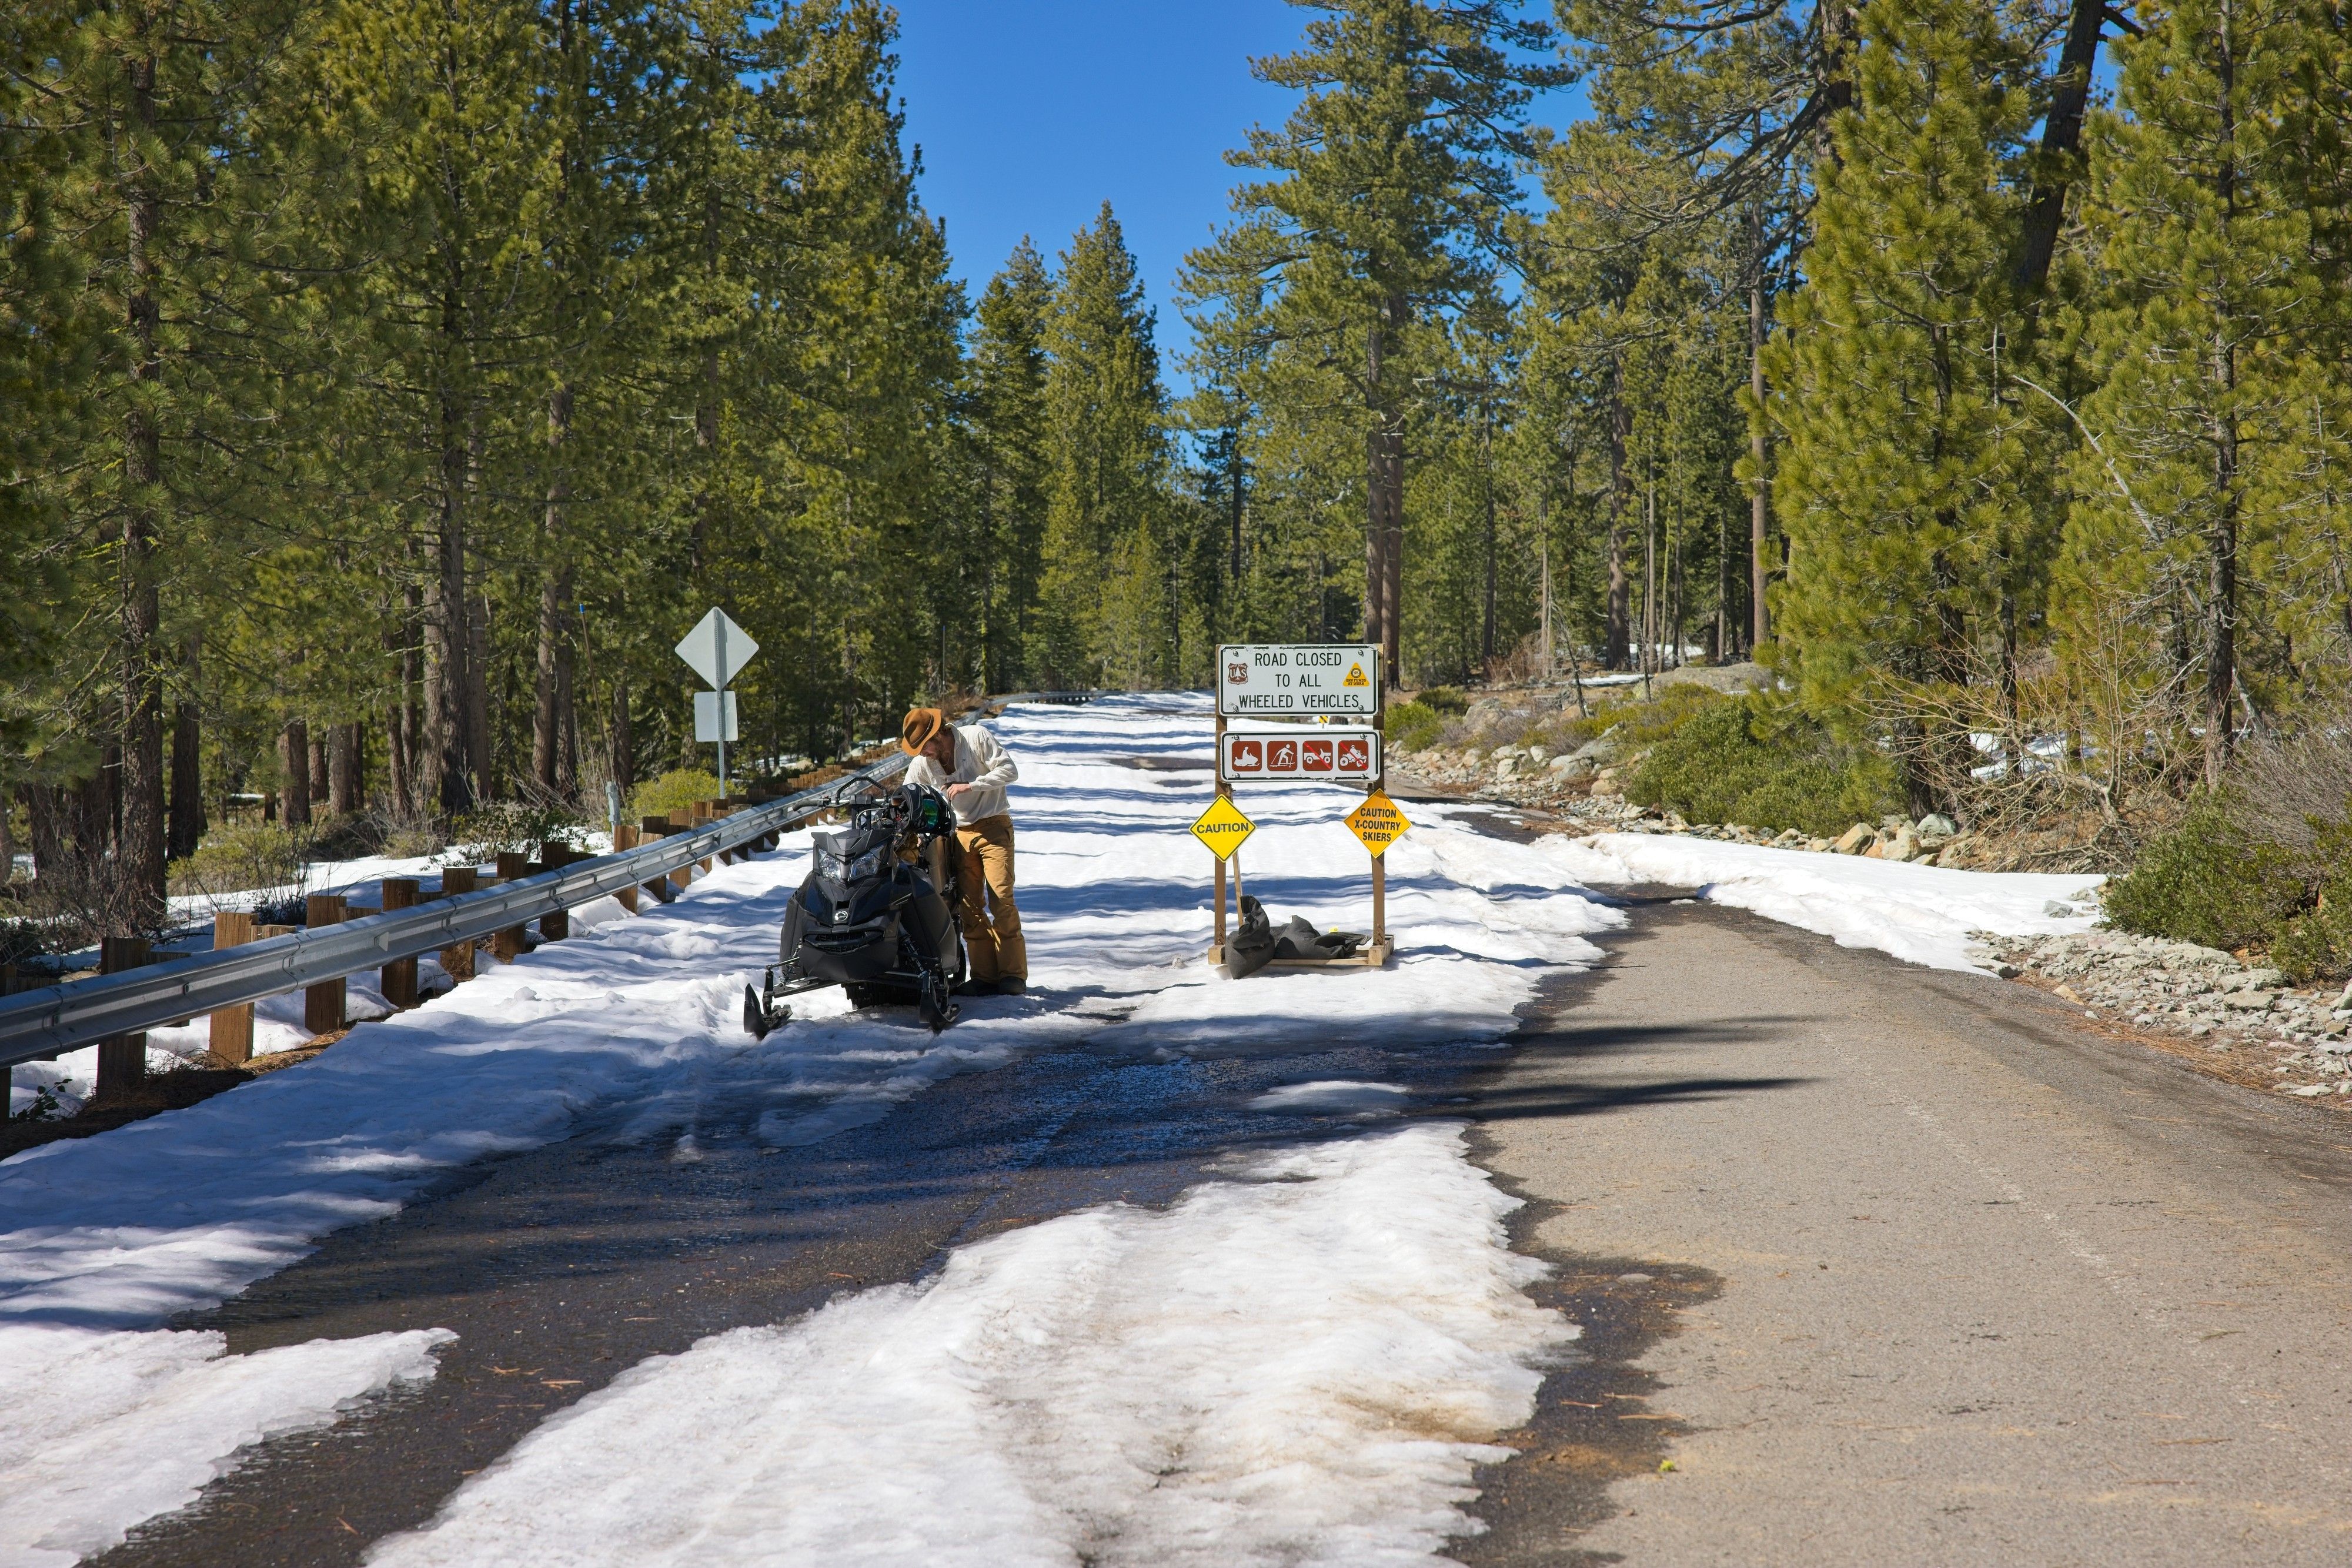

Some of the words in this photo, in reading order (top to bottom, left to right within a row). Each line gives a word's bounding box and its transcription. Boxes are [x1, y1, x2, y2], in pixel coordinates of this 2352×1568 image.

[1255, 653, 1287, 666] ROAD
[1295, 653, 1342, 666] CLOSED
[1275, 674, 1290, 687] TO
[1299, 674, 1321, 687] ALL
[1239, 694, 1293, 708] WHEELED
[1302, 694, 1359, 708] VEHICLES
[1360, 807, 1396, 818] CAUTION
[1196, 822, 1250, 834] CAUTION
[1354, 818, 1401, 831] X-COUNTRY
[1362, 831, 1392, 842] SKIERS
